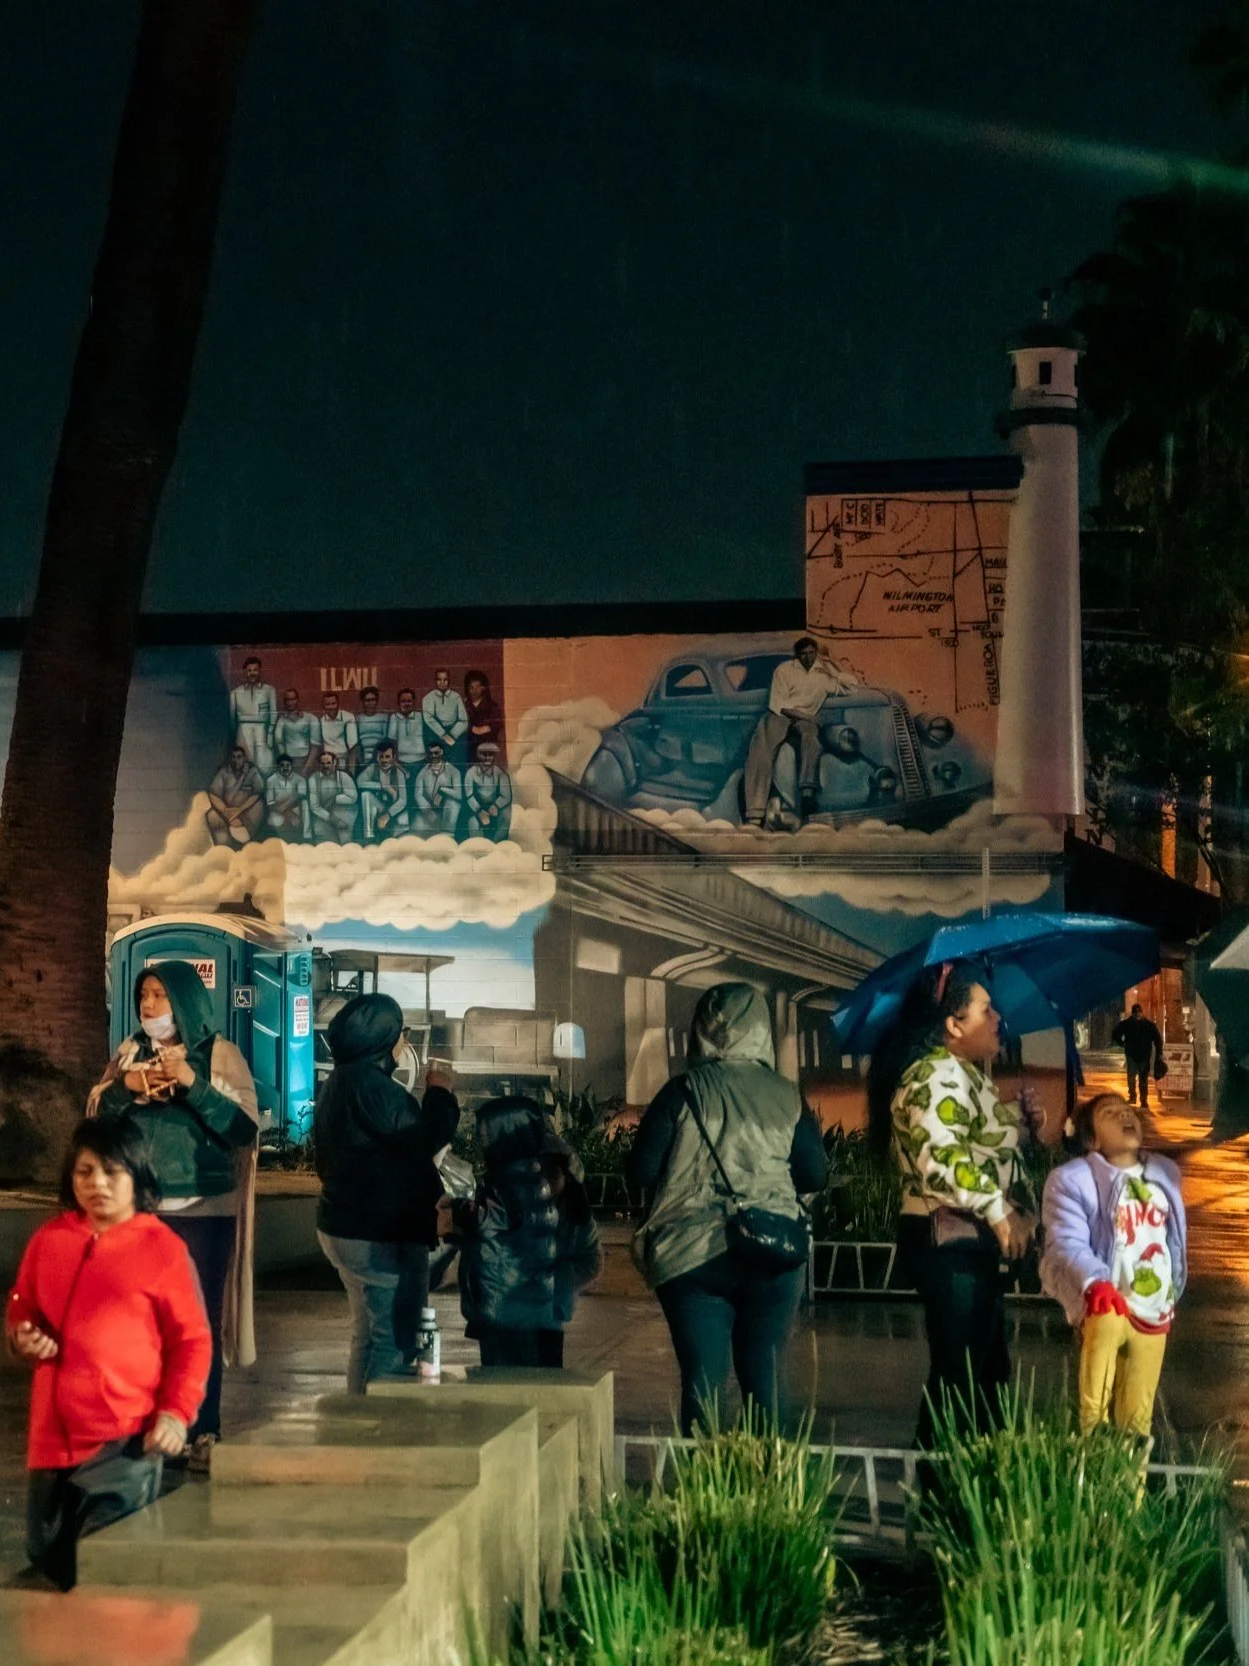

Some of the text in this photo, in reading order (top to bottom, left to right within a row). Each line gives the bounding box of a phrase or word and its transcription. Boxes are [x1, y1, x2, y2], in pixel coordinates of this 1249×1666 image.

[883, 591, 954, 602] WILMINGTON
[887, 603, 944, 613] AIRPORT
[982, 643, 1000, 706] FIGUEROA
